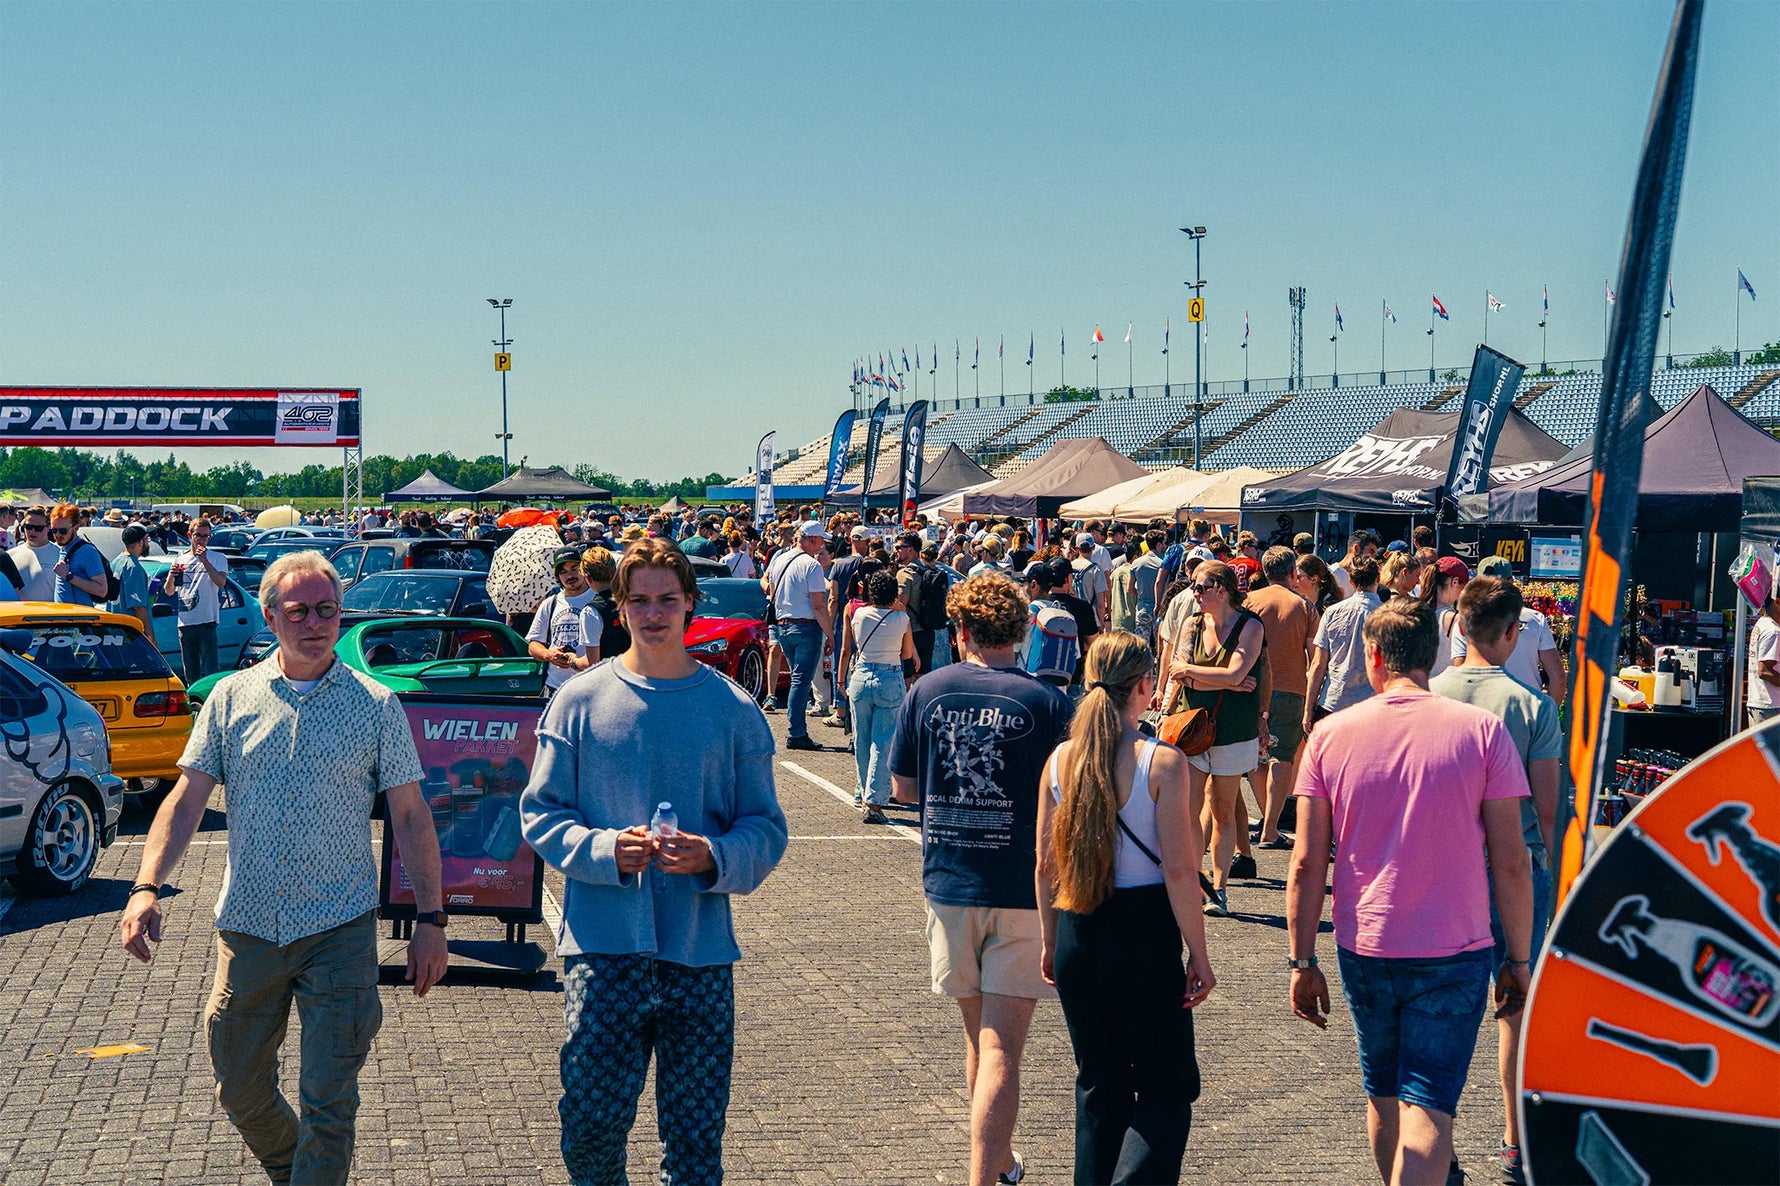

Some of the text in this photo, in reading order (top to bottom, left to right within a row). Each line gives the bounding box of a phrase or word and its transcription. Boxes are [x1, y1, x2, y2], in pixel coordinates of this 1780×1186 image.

[1191, 301, 1201, 319] Q
[499, 355, 507, 368] P
[1489, 366, 1511, 409] SHOP.NL
[0, 406, 234, 431] PADDOCK
[284, 405, 334, 423] 402
[30, 635, 124, 648] POON
[929, 704, 1025, 730] Anti Blue
[422, 718, 519, 741] WIELEN
[454, 739, 520, 754] PAKKET
[926, 794, 1014, 808] LOCAL DENIM SUPPORT
[473, 867, 509, 877] Nu voor
